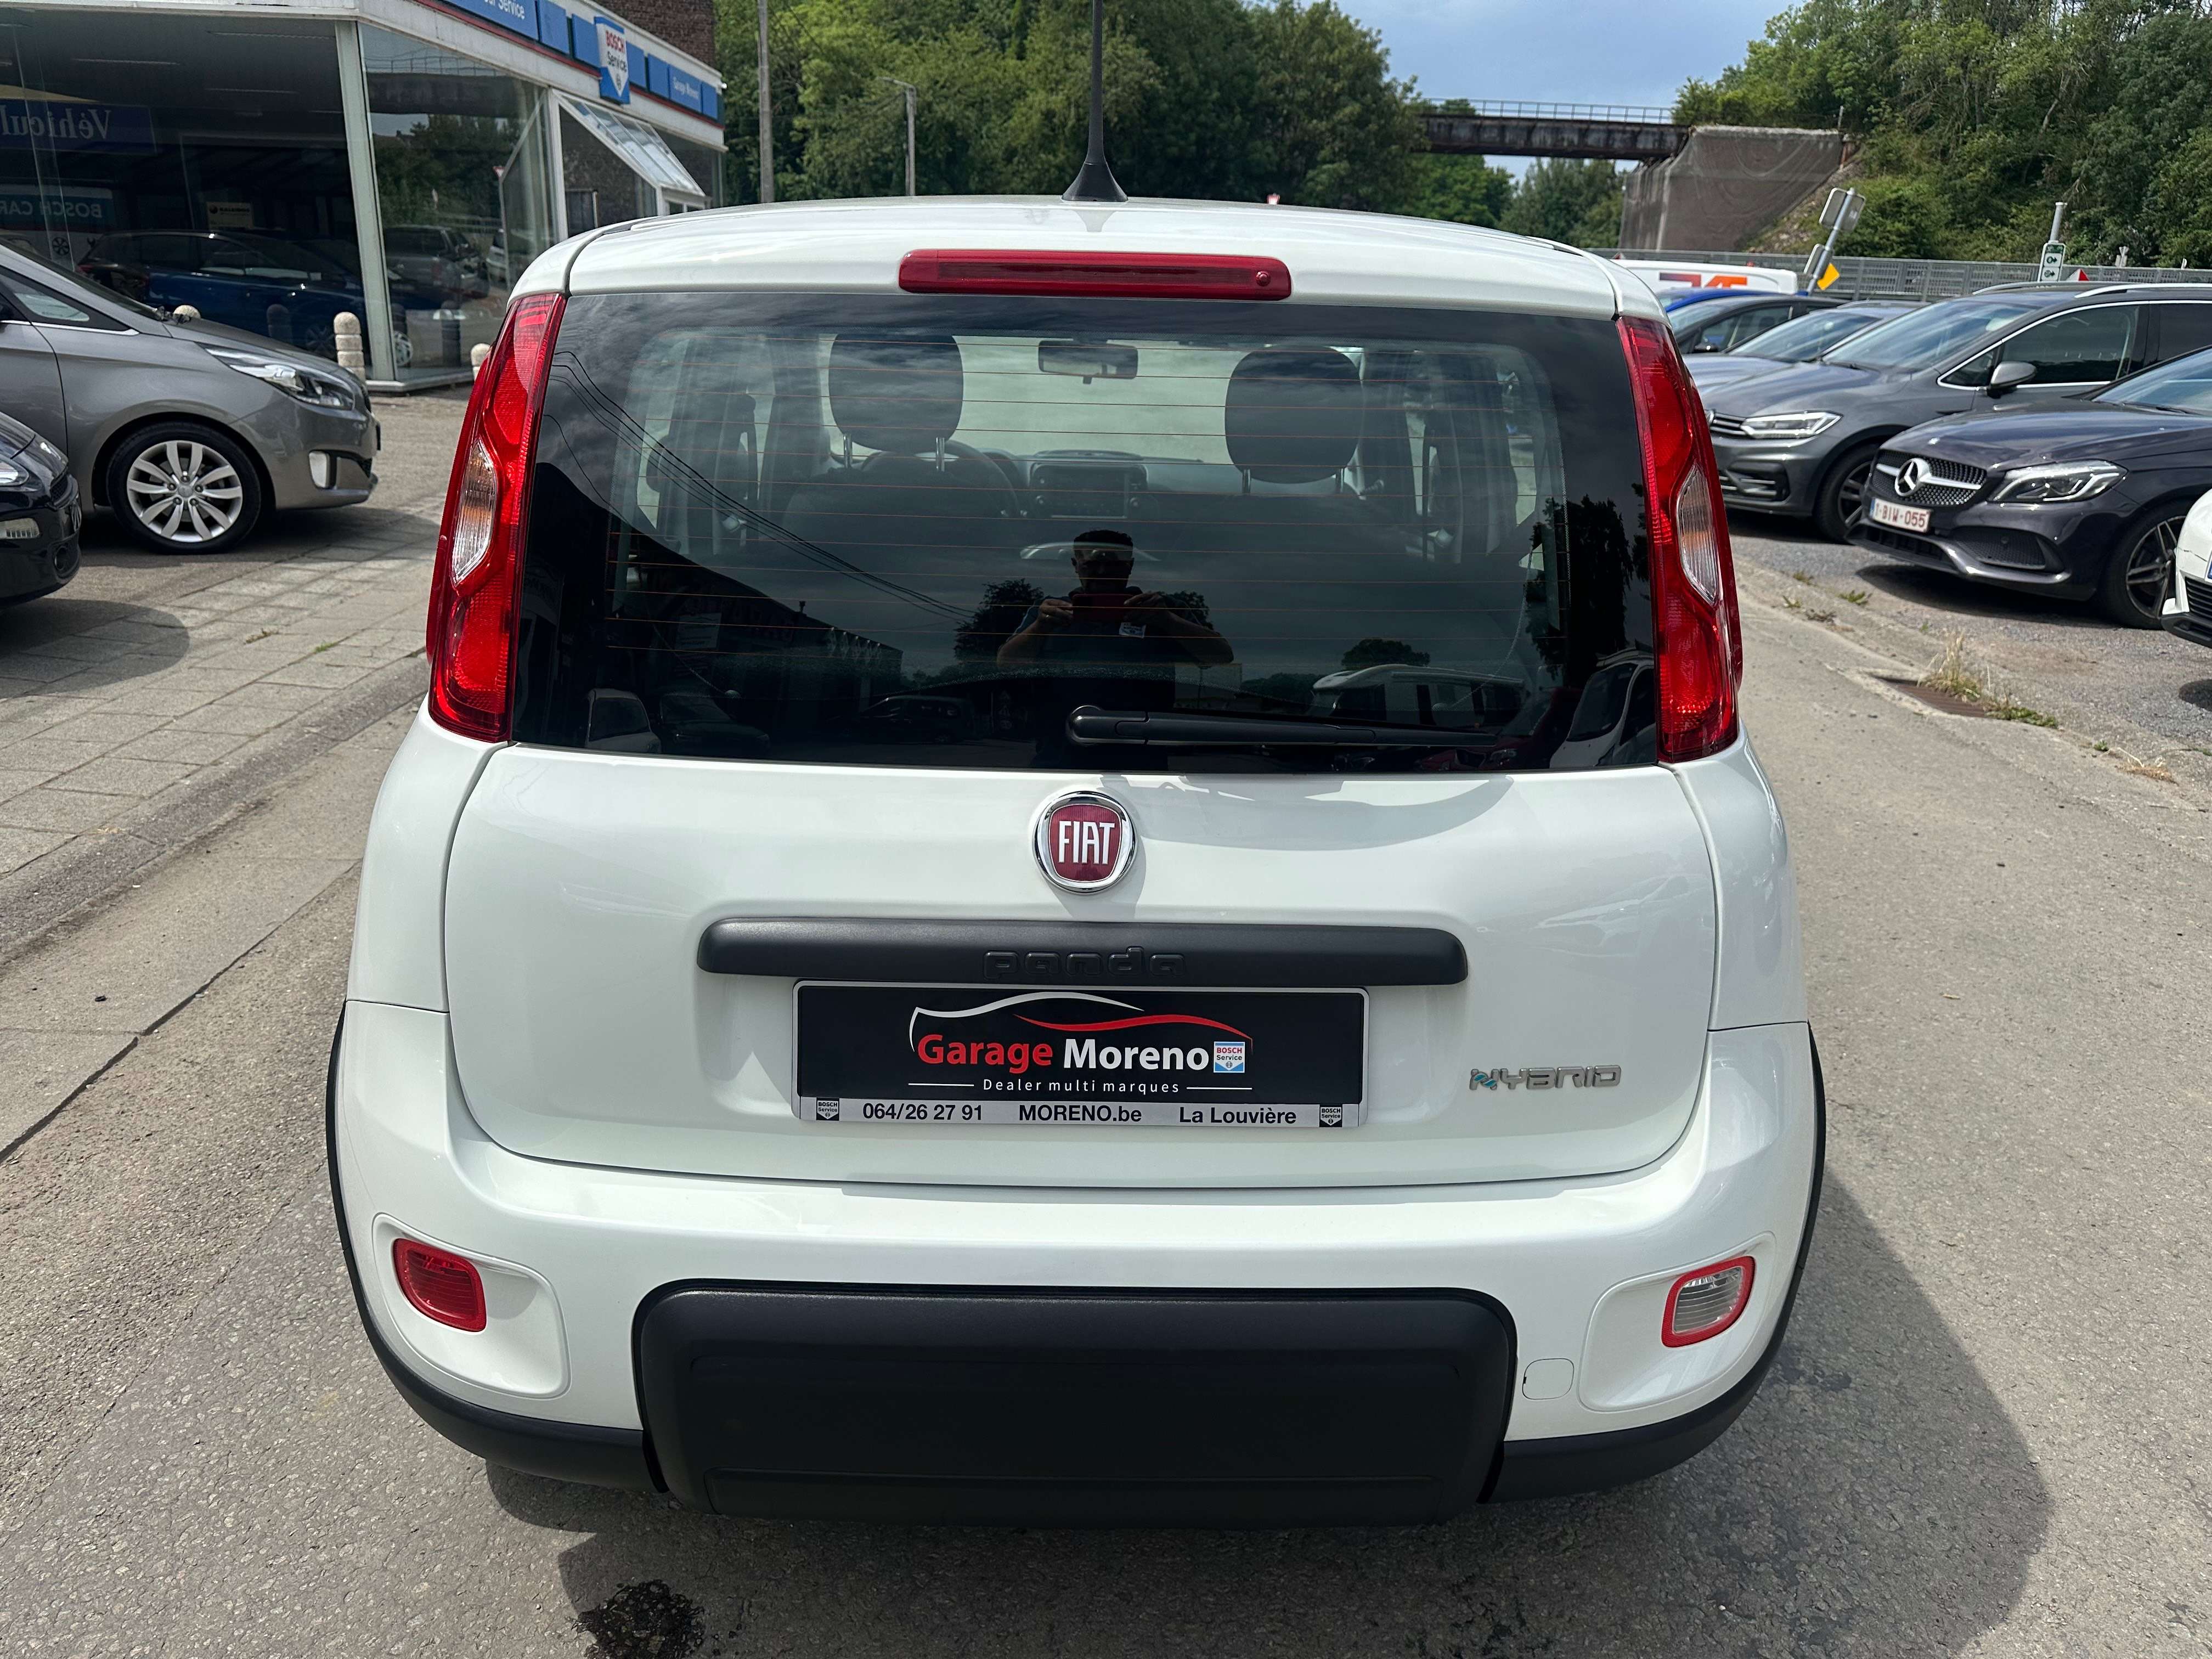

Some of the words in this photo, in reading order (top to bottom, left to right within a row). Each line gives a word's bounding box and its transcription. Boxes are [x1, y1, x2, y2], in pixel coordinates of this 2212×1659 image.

[605, 30, 625, 53] BOSCH
[607, 50, 628, 72] Service
[1059, 821, 1115, 865] FIAT
[983, 945, 1186, 980] panda
[918, 1034, 1053, 1074] Garage
[1063, 1039, 1209, 1070] Moreno
[983, 1079, 1042, 1091] Dealer
[1048, 1079, 1095, 1092] multi
[1103, 1082, 1179, 1095] marques
[1469, 1064, 1622, 1091] HYBRID
[863, 1103, 928, 1120] 064/26
[933, 1104, 956, 1120] 27
[962, 1104, 981, 1120] 91
[1019, 1104, 1142, 1122] MORENO.be
[1180, 1107, 1203, 1123] La
[1211, 1107, 1296, 1124] Louvière
